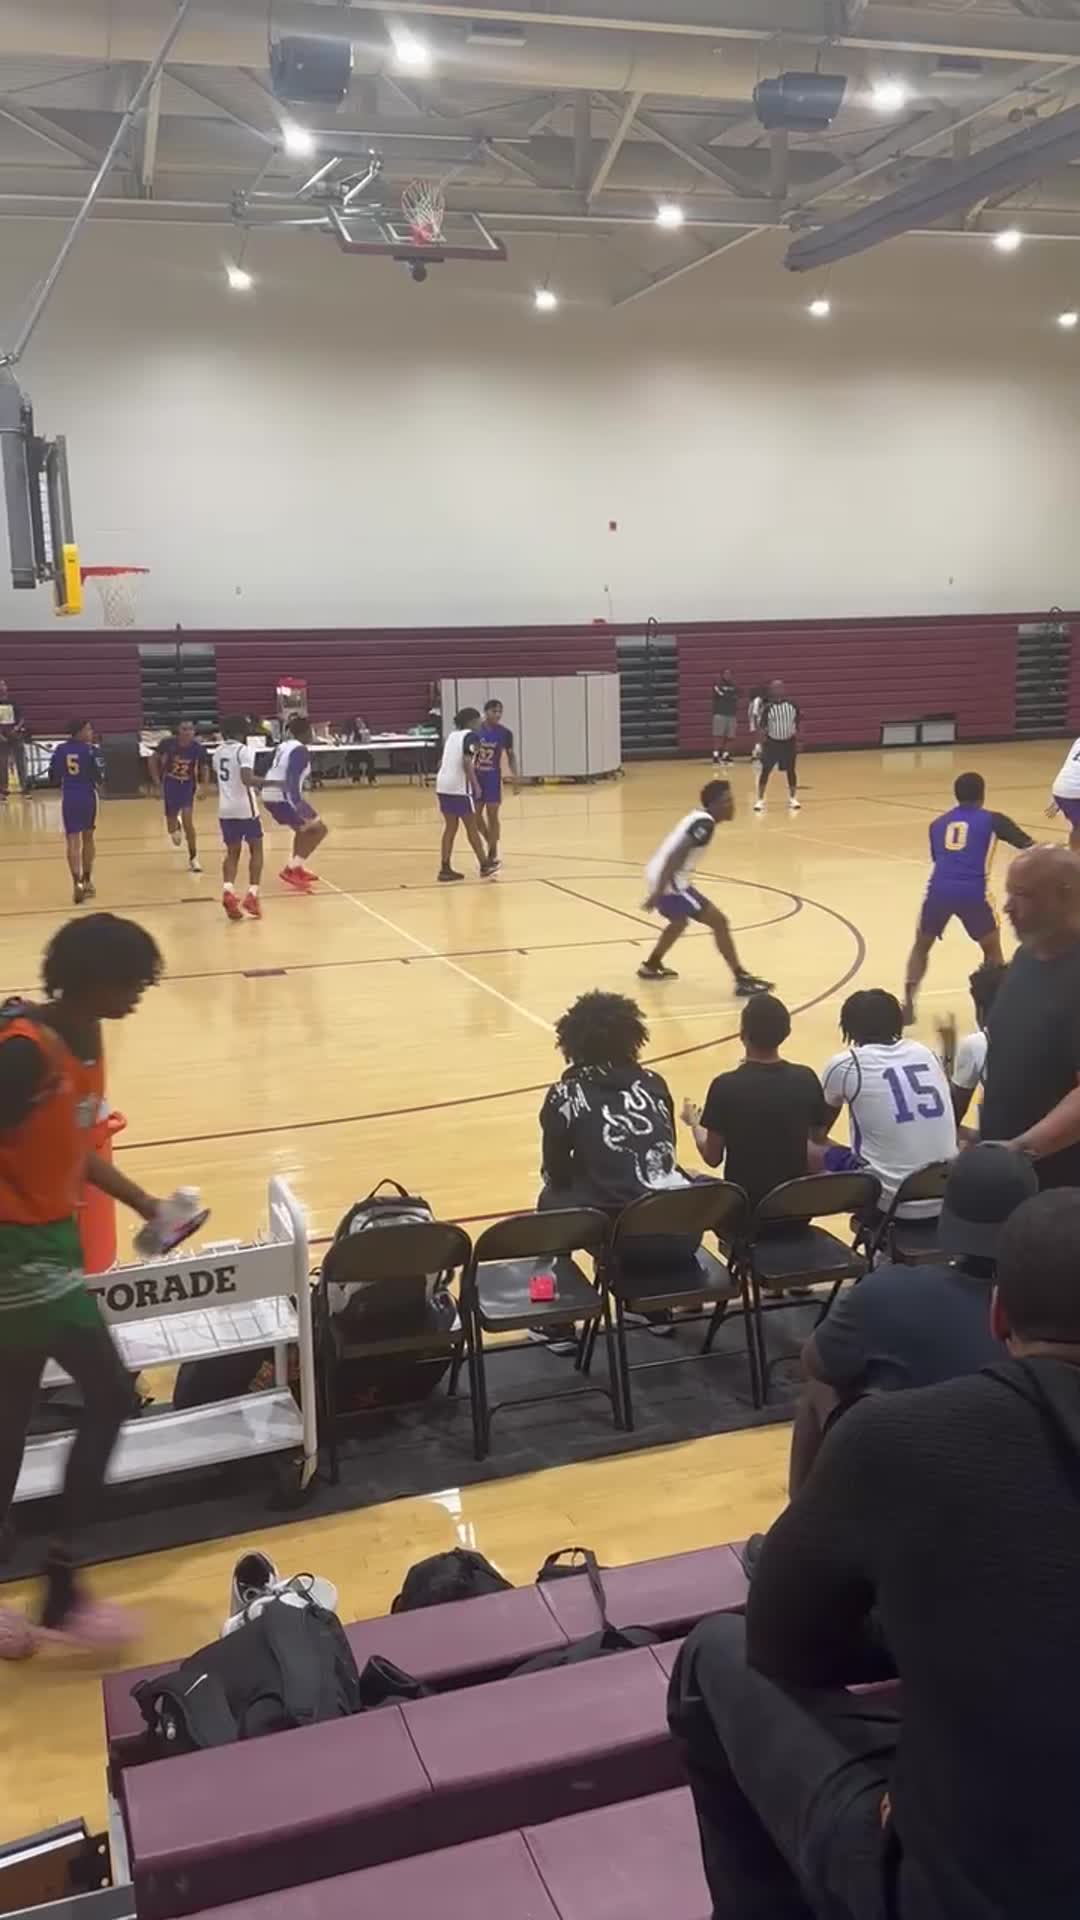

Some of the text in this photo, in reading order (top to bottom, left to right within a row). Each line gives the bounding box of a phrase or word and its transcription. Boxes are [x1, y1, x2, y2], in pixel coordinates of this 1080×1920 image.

[67, 754, 80, 775] 5
[220, 758, 230, 781] 5
[945, 821, 969, 850] 0
[883, 1063, 945, 1124] 15
